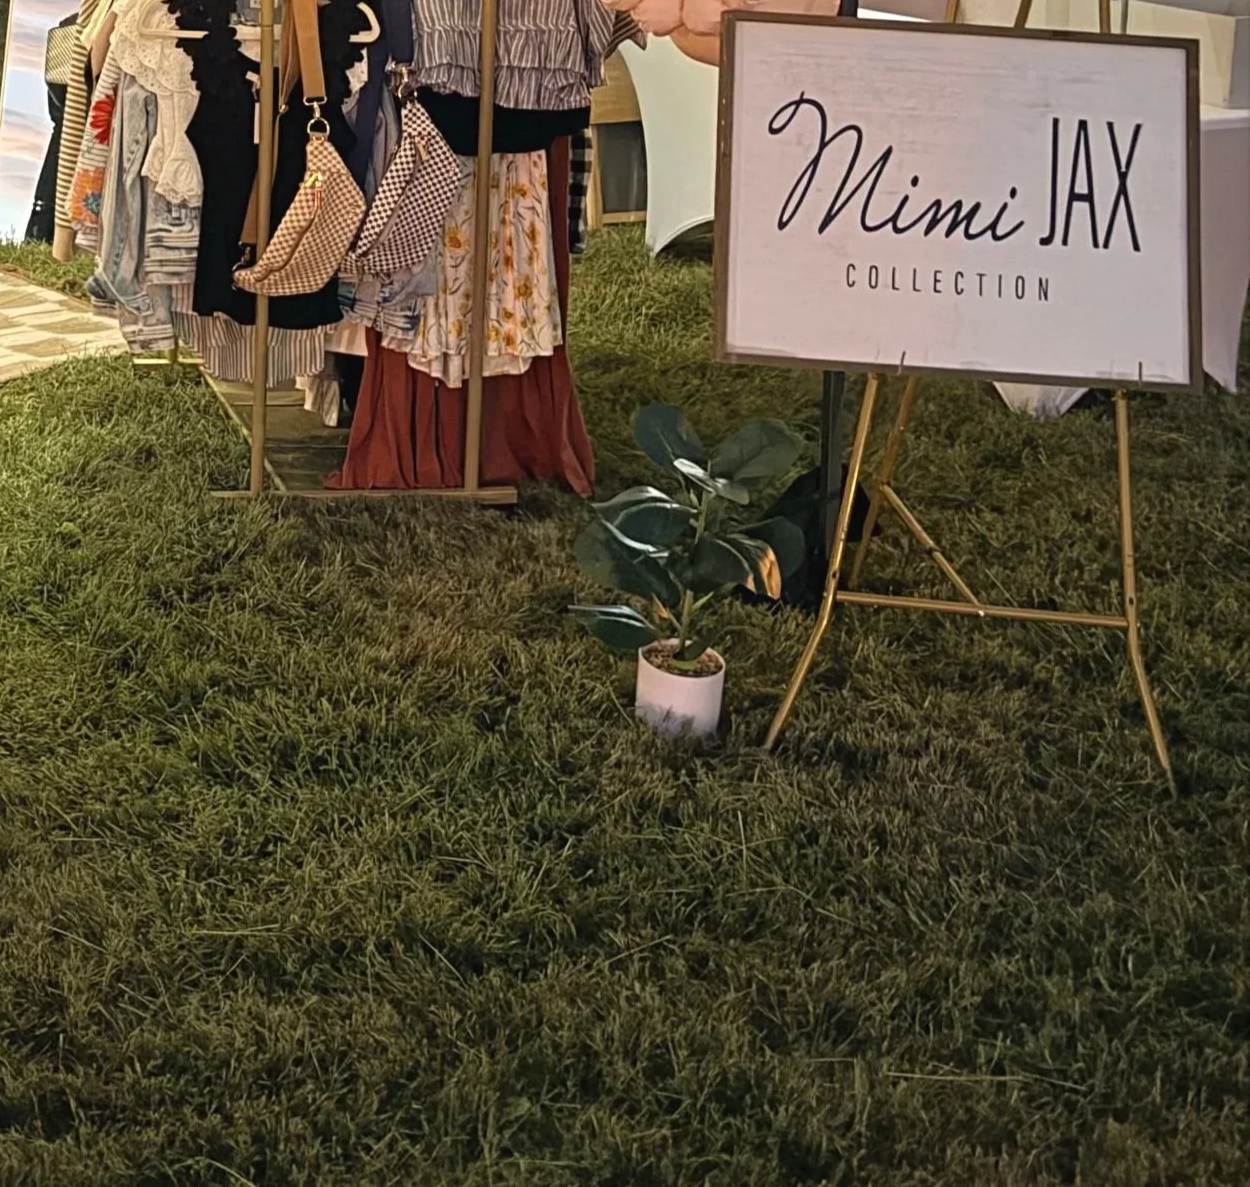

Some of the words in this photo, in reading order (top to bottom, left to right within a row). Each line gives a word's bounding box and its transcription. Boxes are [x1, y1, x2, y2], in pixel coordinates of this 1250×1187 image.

[767, 91, 1025, 242] Mimi
[1038, 117, 1143, 253] JAX
[845, 263, 1050, 302] COLLECTION
